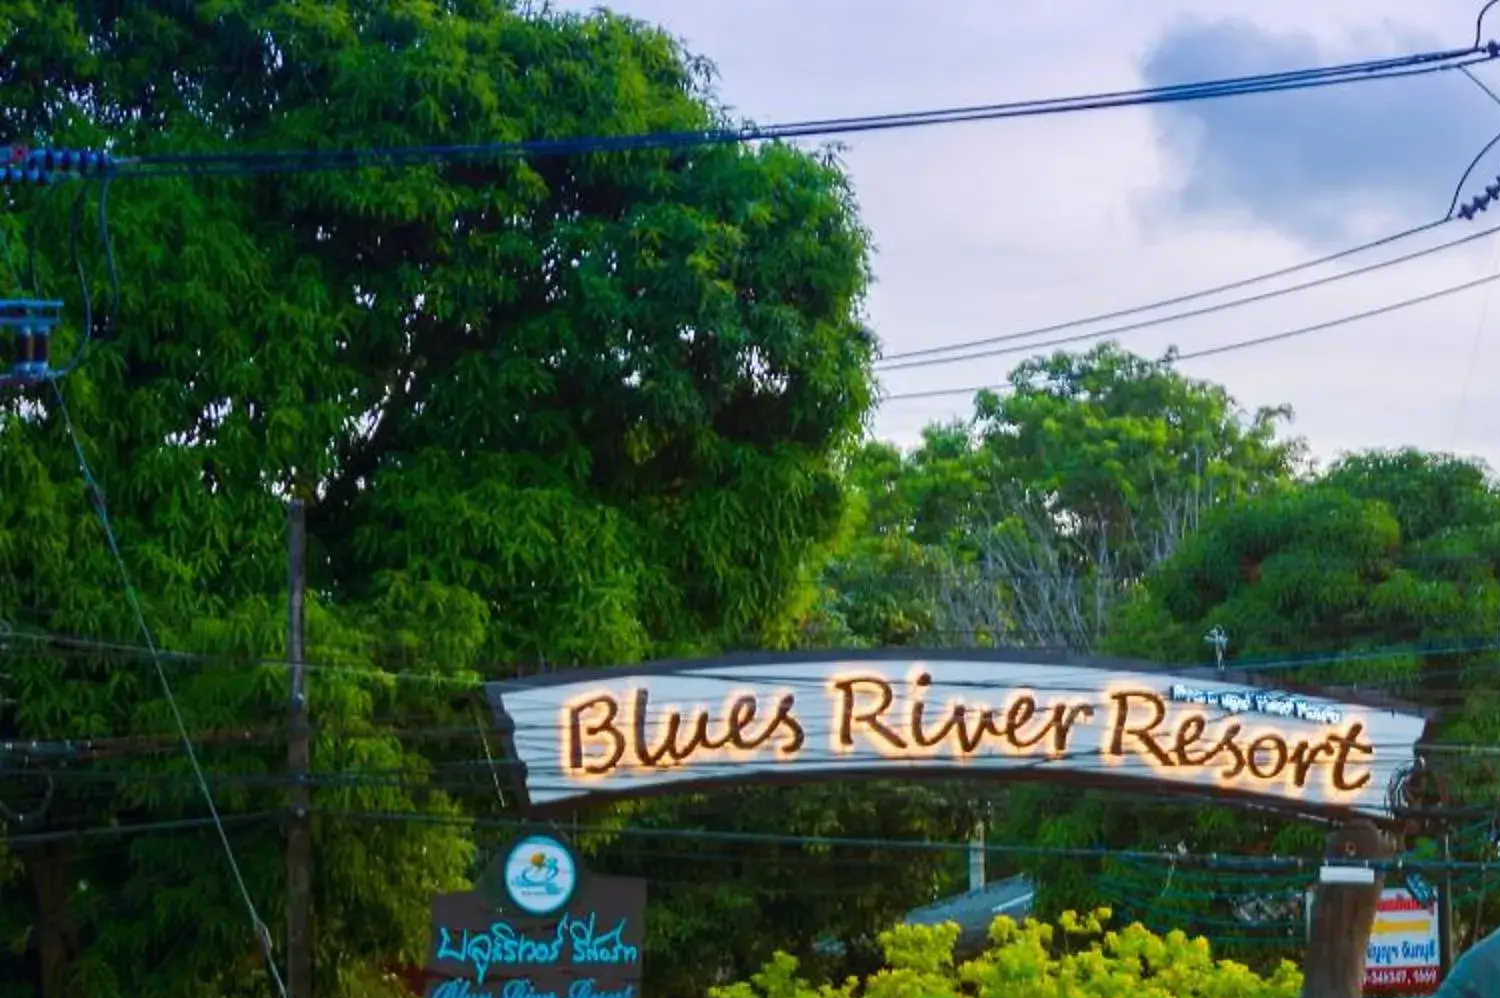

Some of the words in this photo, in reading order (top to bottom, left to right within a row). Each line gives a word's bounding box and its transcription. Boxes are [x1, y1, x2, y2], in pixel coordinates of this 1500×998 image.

[566, 689, 804, 774] Blues
[832, 671, 1093, 758] River
[1108, 689, 1374, 793] Resort
